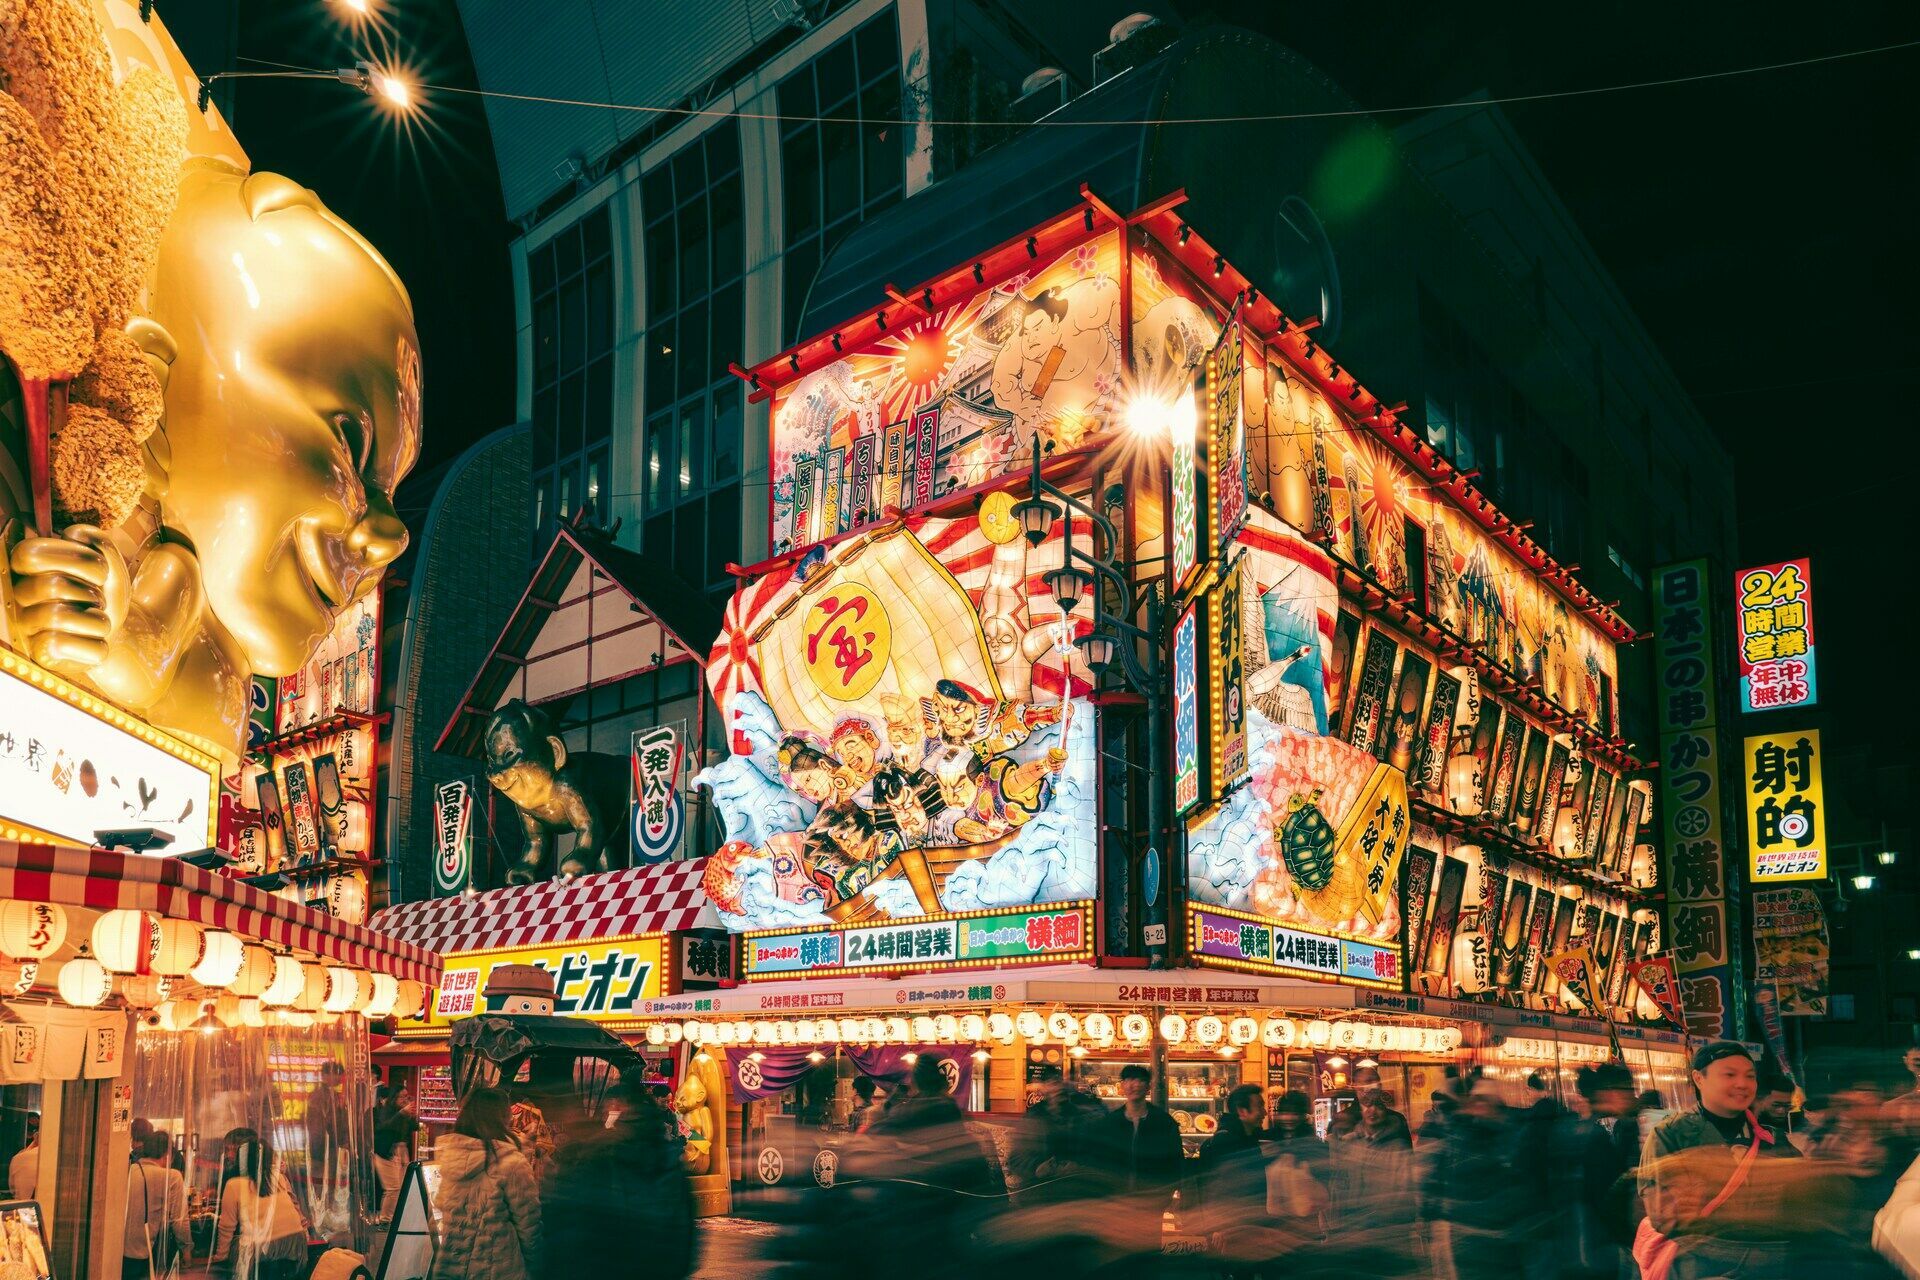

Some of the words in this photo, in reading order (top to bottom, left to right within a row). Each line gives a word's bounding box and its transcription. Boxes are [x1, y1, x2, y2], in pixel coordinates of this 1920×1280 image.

[1742, 564, 1805, 608] 24
[1742, 601, 1806, 635] 時間
[1745, 630, 1807, 663] 営業
[1662, 567, 1711, 802] 日本一の串かつ
[1751, 660, 1807, 686] 年中
[1175, 612, 1195, 776] 横綱
[1751, 682, 1809, 709] 無休
[640, 727, 675, 825] 一発入魂
[1752, 737, 1816, 848] 射的
[440, 780, 466, 863] 百発百中
[1756, 861, 1819, 876] チャンピオン
[1757, 851, 1818, 863] 新世界遊技場
[1672, 840, 1721, 963] 横綱
[848, 927, 952, 963] 24時間営業
[969, 926, 1025, 949] 日本一の串かつ
[1025, 912, 1081, 951] 横綱
[1145, 926, 1165, 943] 9-22
[1202, 926, 1239, 947] 日本一の串かつ
[1239, 923, 1270, 960] 横綱
[757, 947, 799, 963] 日本一の串かつ
[800, 934, 842, 966] 横綱
[1275, 932, 1339, 971] 24時間営業
[1373, 949, 1398, 979] 横綱
[442, 970, 479, 992] 新世界
[484, 951, 651, 1014] ピオン
[908, 988, 965, 1002] 日本一の串かつ
[967, 986, 993, 1001] 横綱
[1118, 985, 1203, 1003] 24時間営業
[1207, 987, 1258, 1003] 年中無休
[438, 993, 475, 1014] 遊技場
[652, 1001, 693, 1013] 日本一の串かつ
[760, 993, 809, 1009] 24時間営業
